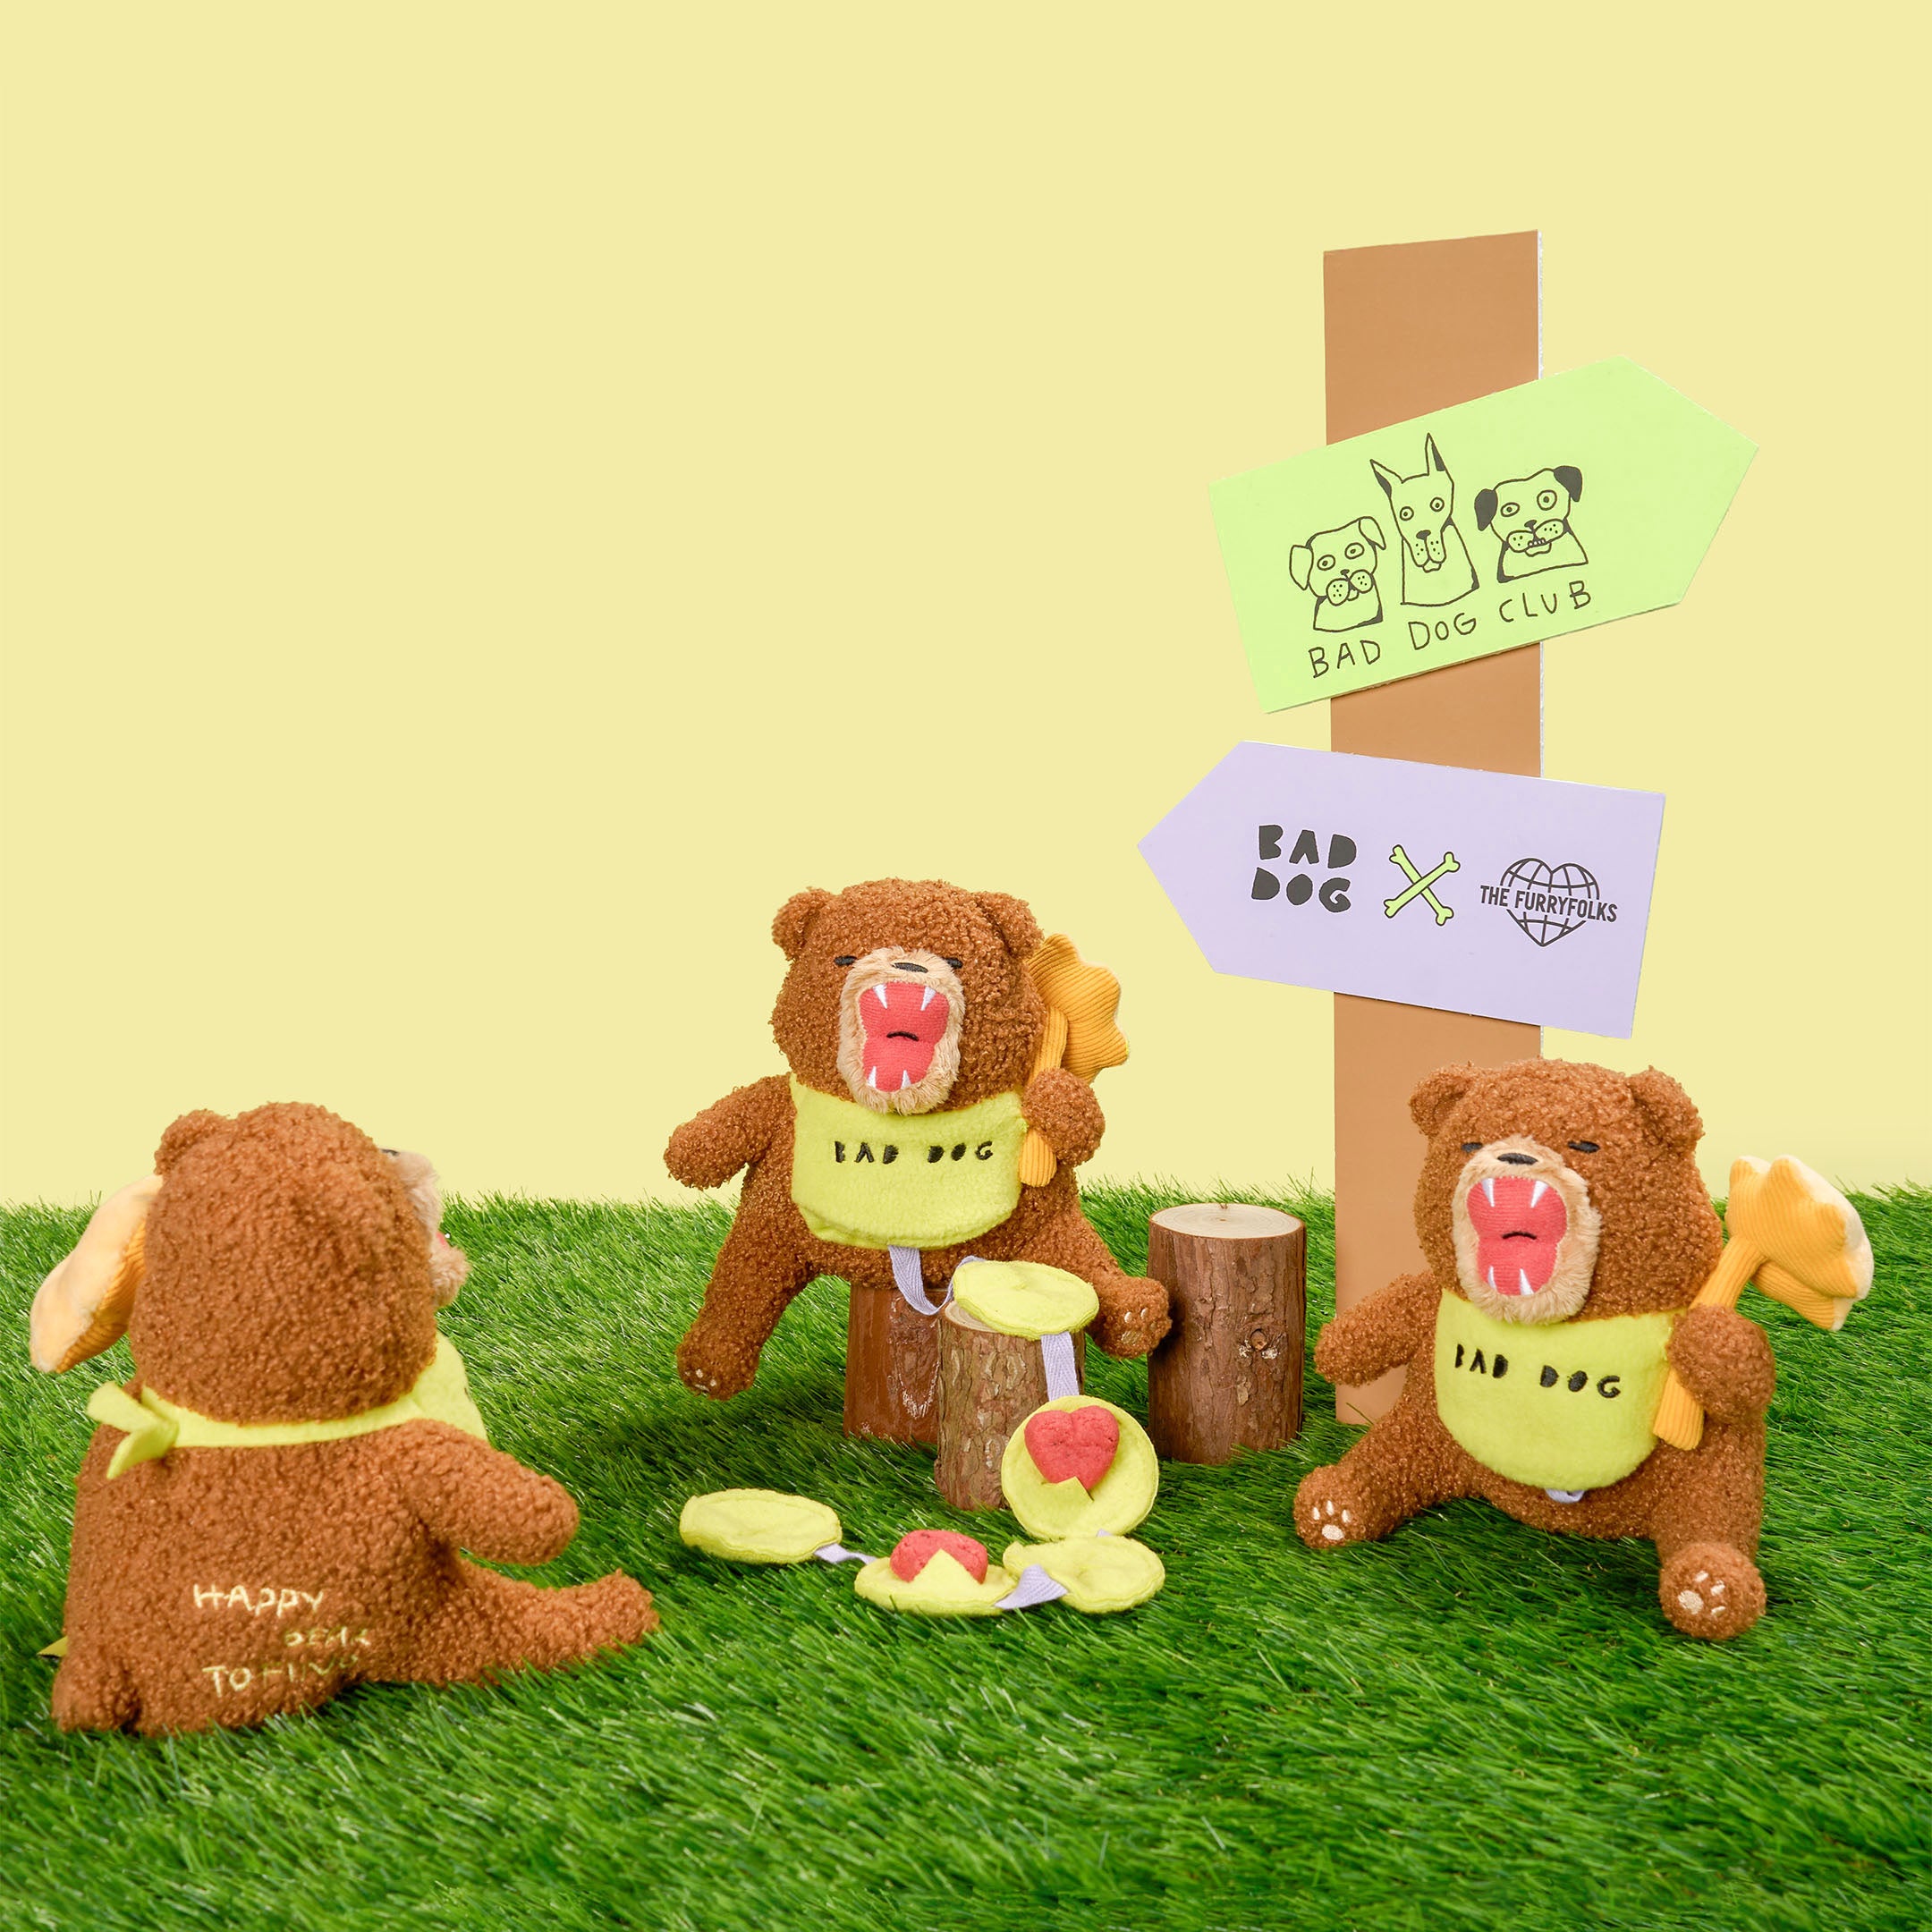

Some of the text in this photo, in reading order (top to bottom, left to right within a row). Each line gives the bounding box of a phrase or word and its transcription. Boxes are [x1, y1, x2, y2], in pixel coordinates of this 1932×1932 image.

[1308, 580, 1592, 678] BAD DOG CLUB
[1258, 824, 1358, 869] BAD
[1250, 866, 1352, 913] DOG
[1479, 884, 1619, 924] THE FURRYFOLKS
[834, 1140, 995, 1165] BAD DOG
[1454, 1343, 1622, 1399] BAD DOG
[201, 1664, 253, 1698] TO
